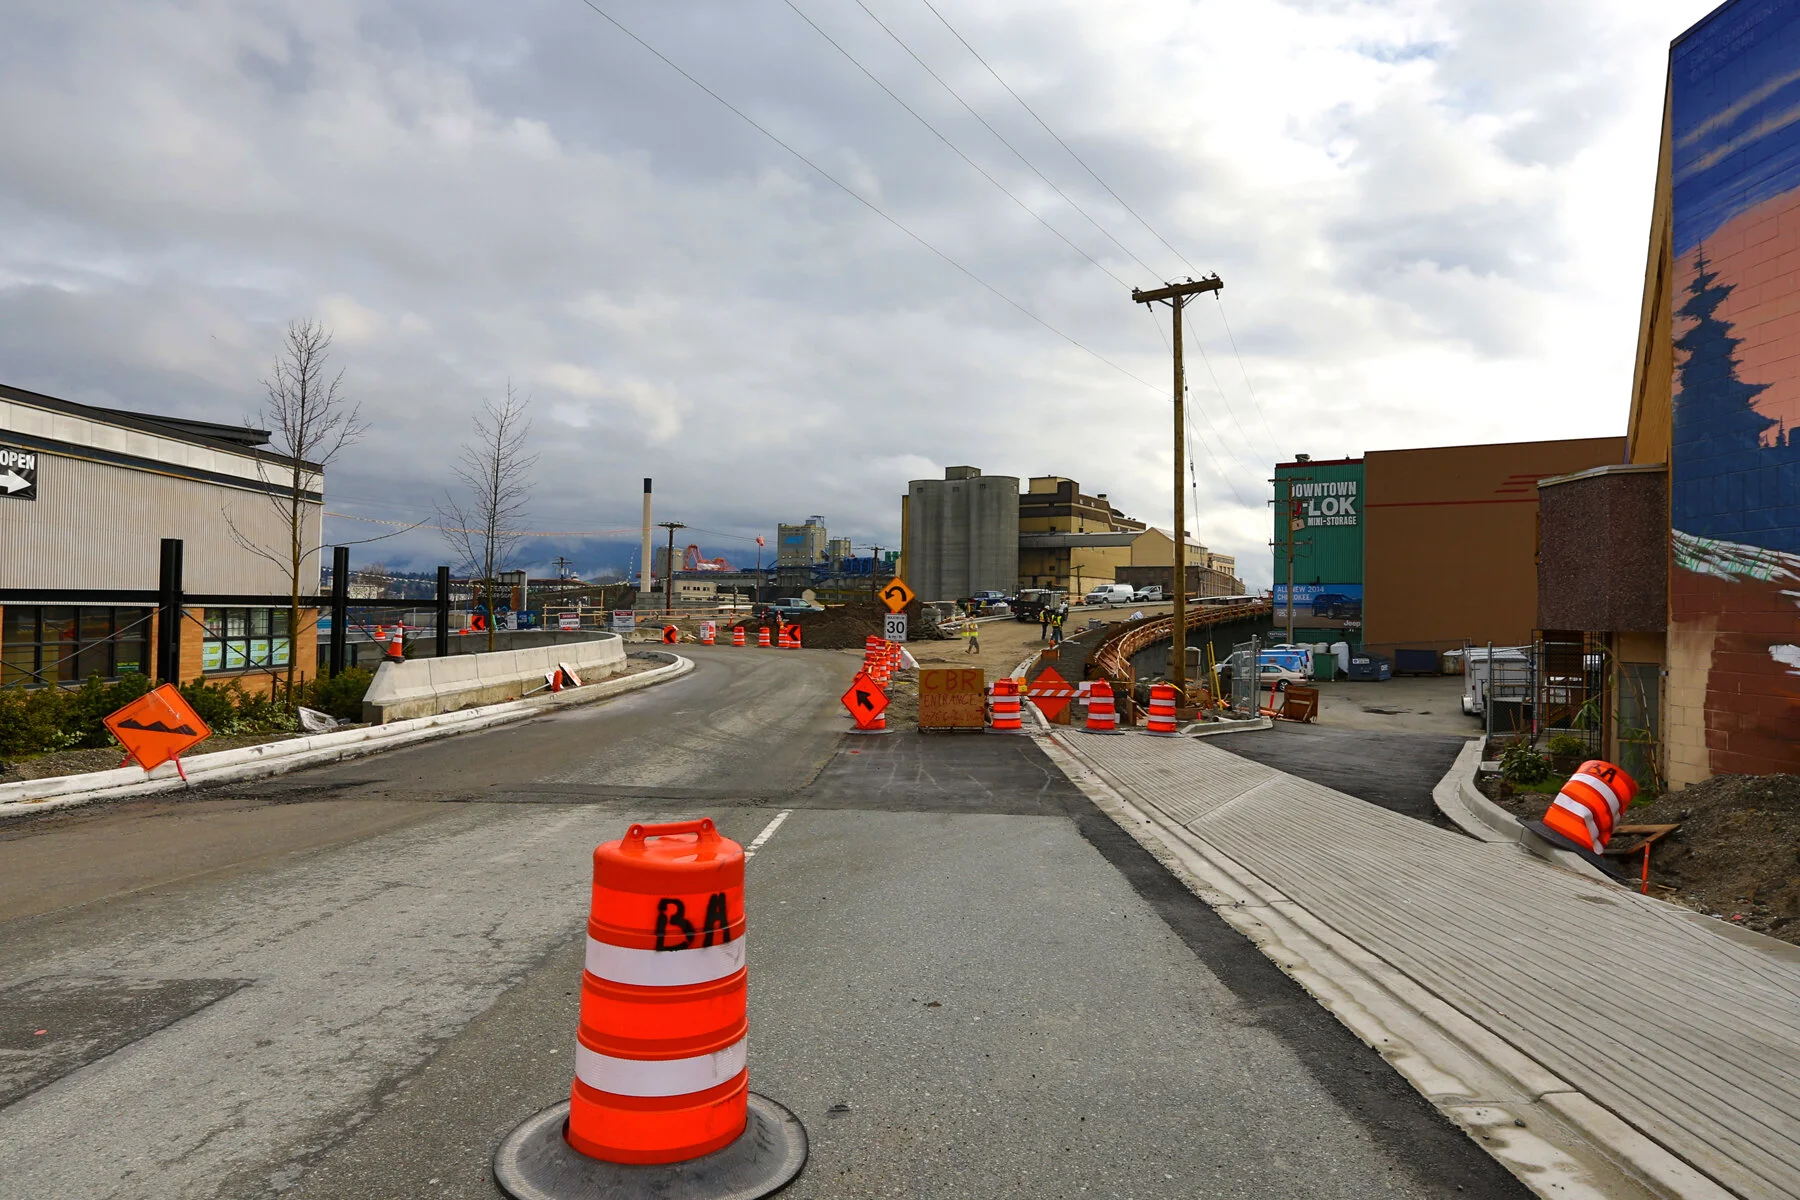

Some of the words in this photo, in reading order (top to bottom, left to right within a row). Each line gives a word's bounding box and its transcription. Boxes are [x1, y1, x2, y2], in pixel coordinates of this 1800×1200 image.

[0, 450, 35, 470] OPEN
[1308, 516, 1357, 526] MINI-STORAGE
[887, 621, 905, 634] 30
[1343, 620, 1361, 628] Jeep
[924, 669, 978, 692] CBR
[923, 692, 977, 708] ENTRANCE
[655, 892, 731, 953] BA
